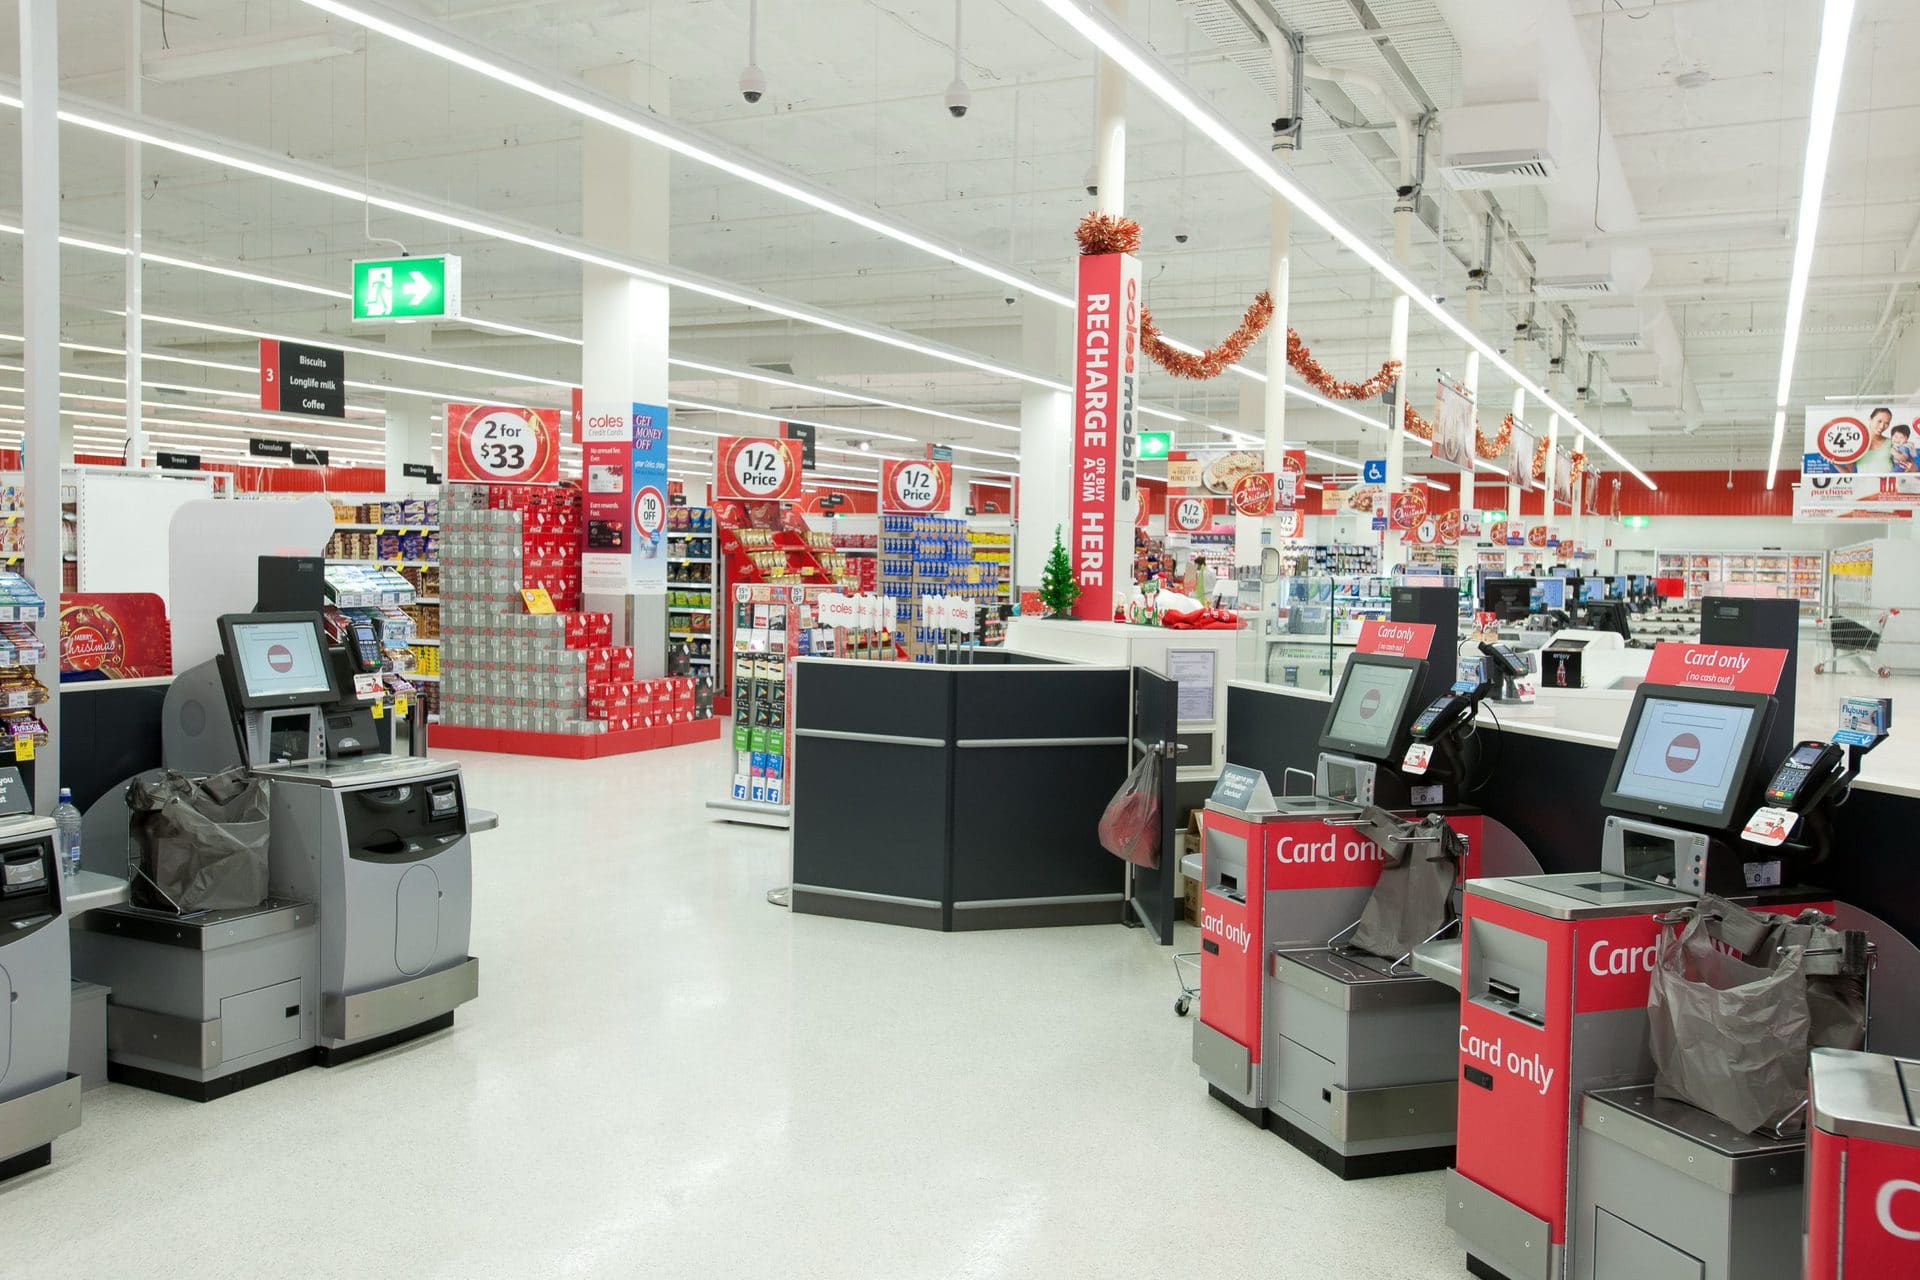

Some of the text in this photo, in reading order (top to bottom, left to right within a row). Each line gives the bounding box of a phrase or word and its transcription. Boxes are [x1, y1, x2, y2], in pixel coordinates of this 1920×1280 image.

[299, 355, 327, 368] Biscuits
[266, 368, 274, 382] 3
[1084, 293, 1110, 447] RECHARGE
[290, 375, 336, 391] Longlife milk
[302, 398, 325, 410] Coffee
[589, 414, 624, 428] coles
[636, 415, 651, 426] GET
[484, 420, 521, 439] 2 for
[636, 427, 663, 440] MONEY
[258, 443, 283, 451] Chocolate
[636, 439, 652, 450] OFF
[481, 442, 525, 469] $33
[745, 450, 776, 471] 1/2
[743, 472, 777, 486] Price
[905, 470, 930, 488] 1/2
[1083, 457, 1096, 502] A SIM
[1095, 457, 1105, 502] OR BUY
[903, 489, 931, 500] Price
[643, 511, 656, 521] OFF
[1184, 504, 1199, 516] 1/2
[1182, 516, 1200, 524] Price
[1080, 512, 1105, 586] HERE
[830, 602, 853, 615] coles
[951, 608, 968, 618] coles
[1378, 625, 1415, 643] Card only
[1684, 649, 1751, 674] Card only
[1700, 673, 1716, 682] cash
[1276, 833, 1385, 864] Card onl
[1225, 922, 1251, 954] only
[1588, 933, 1662, 976] Card
[1459, 1024, 1554, 1095] Card only
